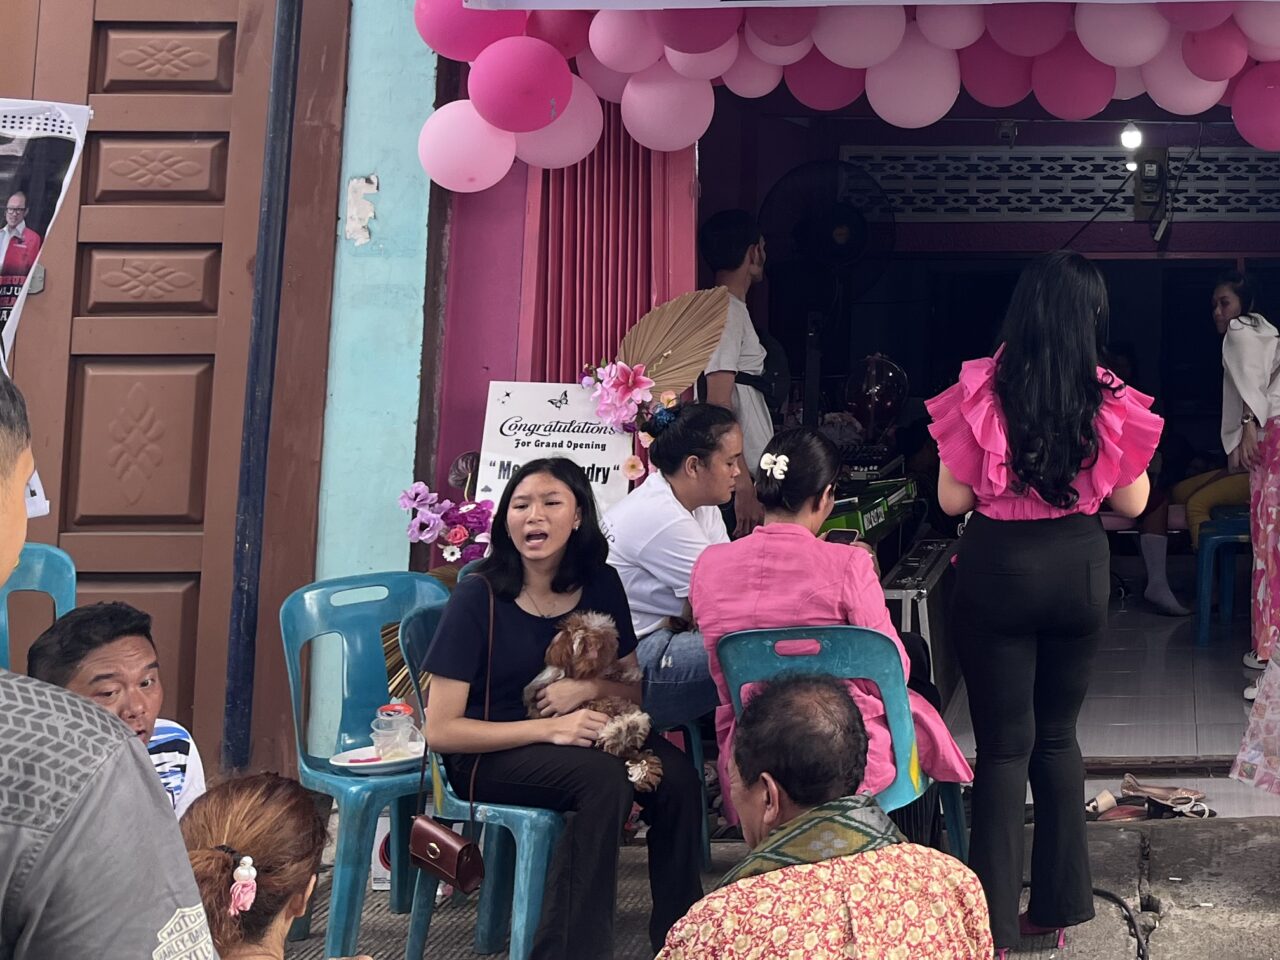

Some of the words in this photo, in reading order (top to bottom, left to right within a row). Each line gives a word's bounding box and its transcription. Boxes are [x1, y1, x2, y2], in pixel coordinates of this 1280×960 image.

[500, 416, 616, 437] Congratulations
[514, 438, 532, 449] For
[534, 439, 564, 449] Grand
[566, 440, 607, 452] Opening
[166, 911, 203, 938] MOTOR
